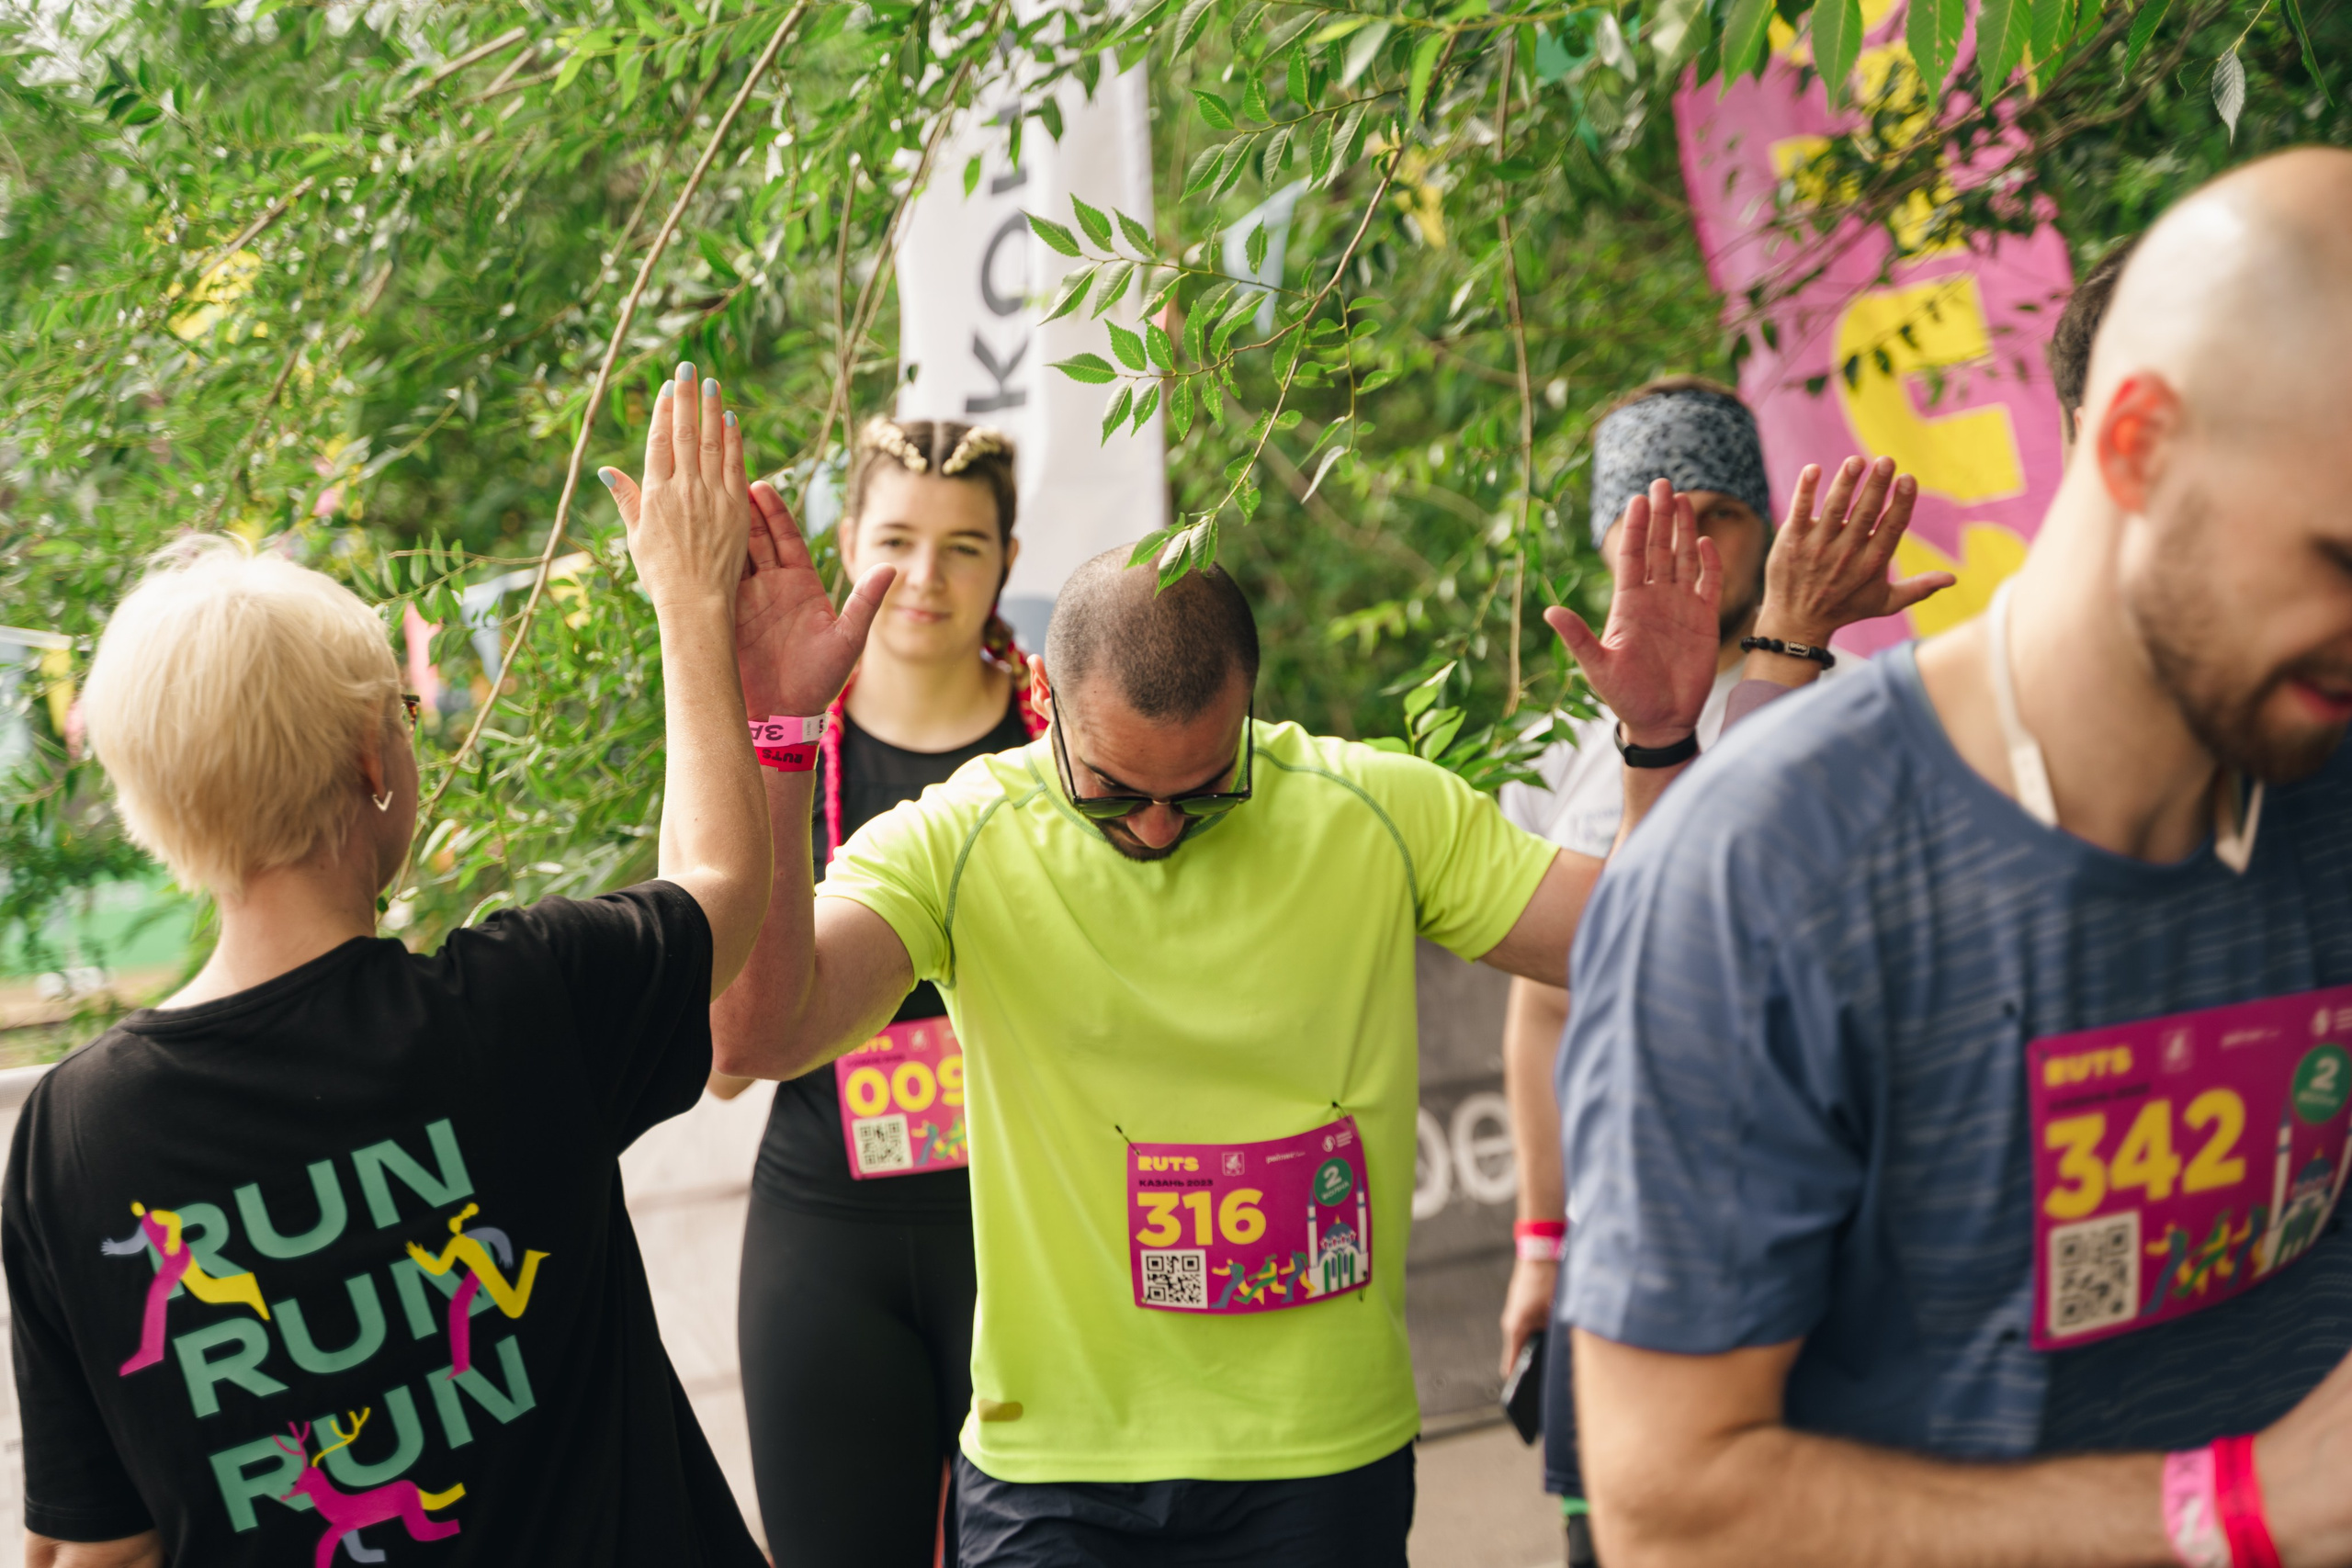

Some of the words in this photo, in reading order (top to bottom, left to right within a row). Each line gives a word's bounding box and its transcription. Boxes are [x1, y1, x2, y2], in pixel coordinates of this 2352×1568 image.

[762, 749, 803, 764] RUTS
[845, 1055, 964, 1118] 009
[2310, 1056, 2340, 1091] 2
[1137, 1156, 1199, 1172] RUTS
[1138, 1179, 1185, 1188] КАЗАНЬ
[1186, 1179, 1214, 1188] 2023
[1323, 1165, 1342, 1190] 2
[2043, 1088, 2246, 1220] 342
[147, 1118, 475, 1301] RUN
[1136, 1188, 1267, 1247] 316
[173, 1239, 499, 1419] RUN
[209, 1335, 537, 1533] RUN
